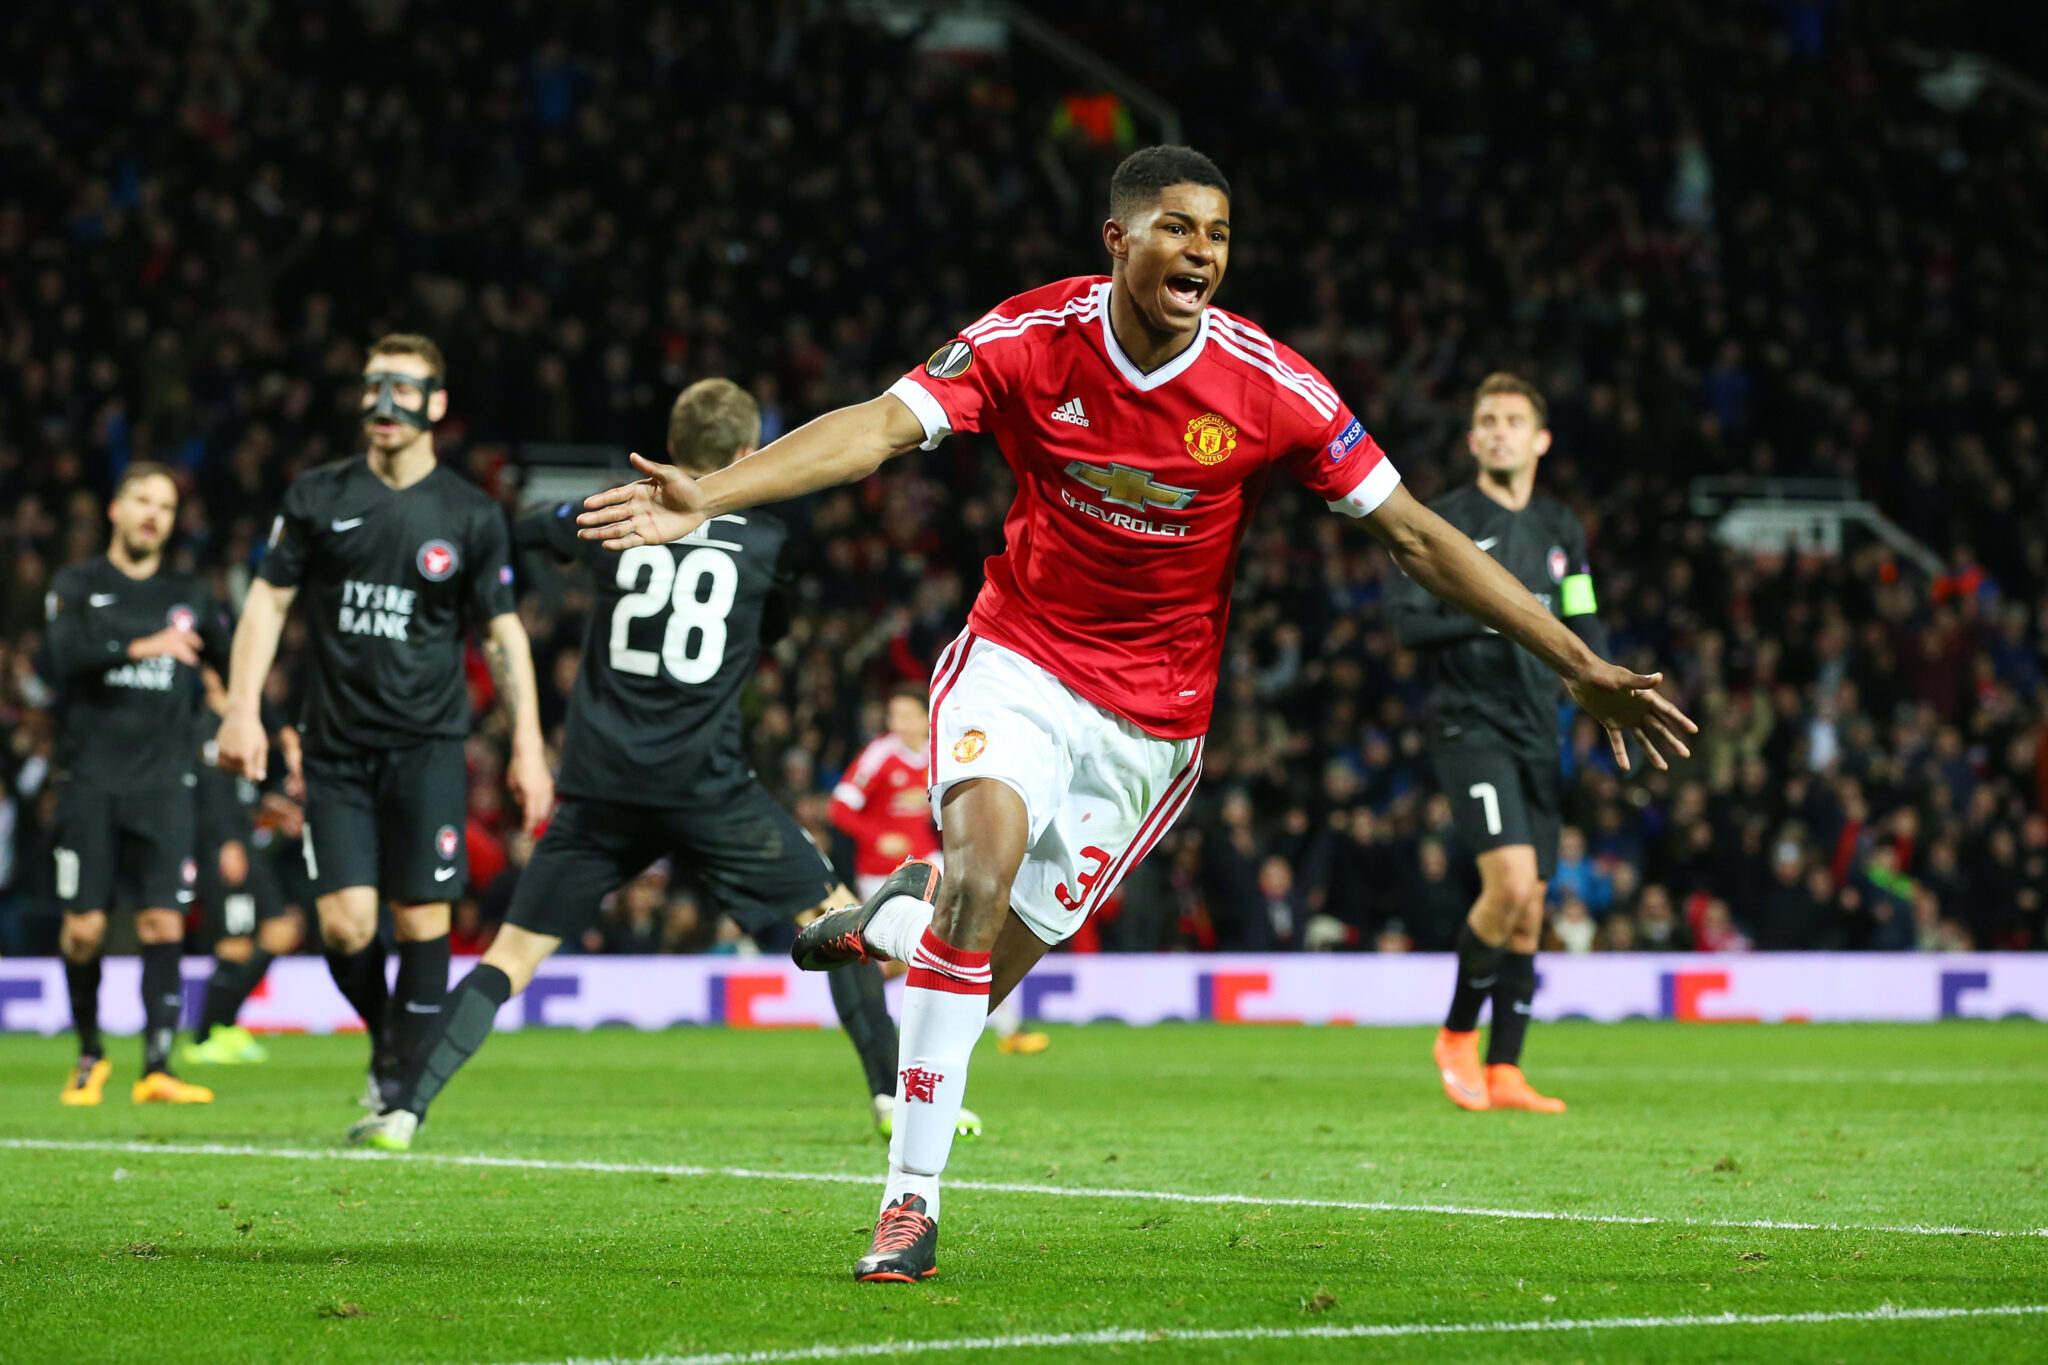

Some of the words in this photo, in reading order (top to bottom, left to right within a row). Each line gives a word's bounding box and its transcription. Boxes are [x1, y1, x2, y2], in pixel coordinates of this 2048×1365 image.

[1051, 411, 1090, 427] adidas
[1191, 416, 1234, 437] MANCHESTER
[1193, 450, 1224, 462] UNITED
[1061, 487, 1191, 537] CHEVROLET
[338, 606, 410, 641] BANK
[608, 543, 739, 684] 28
